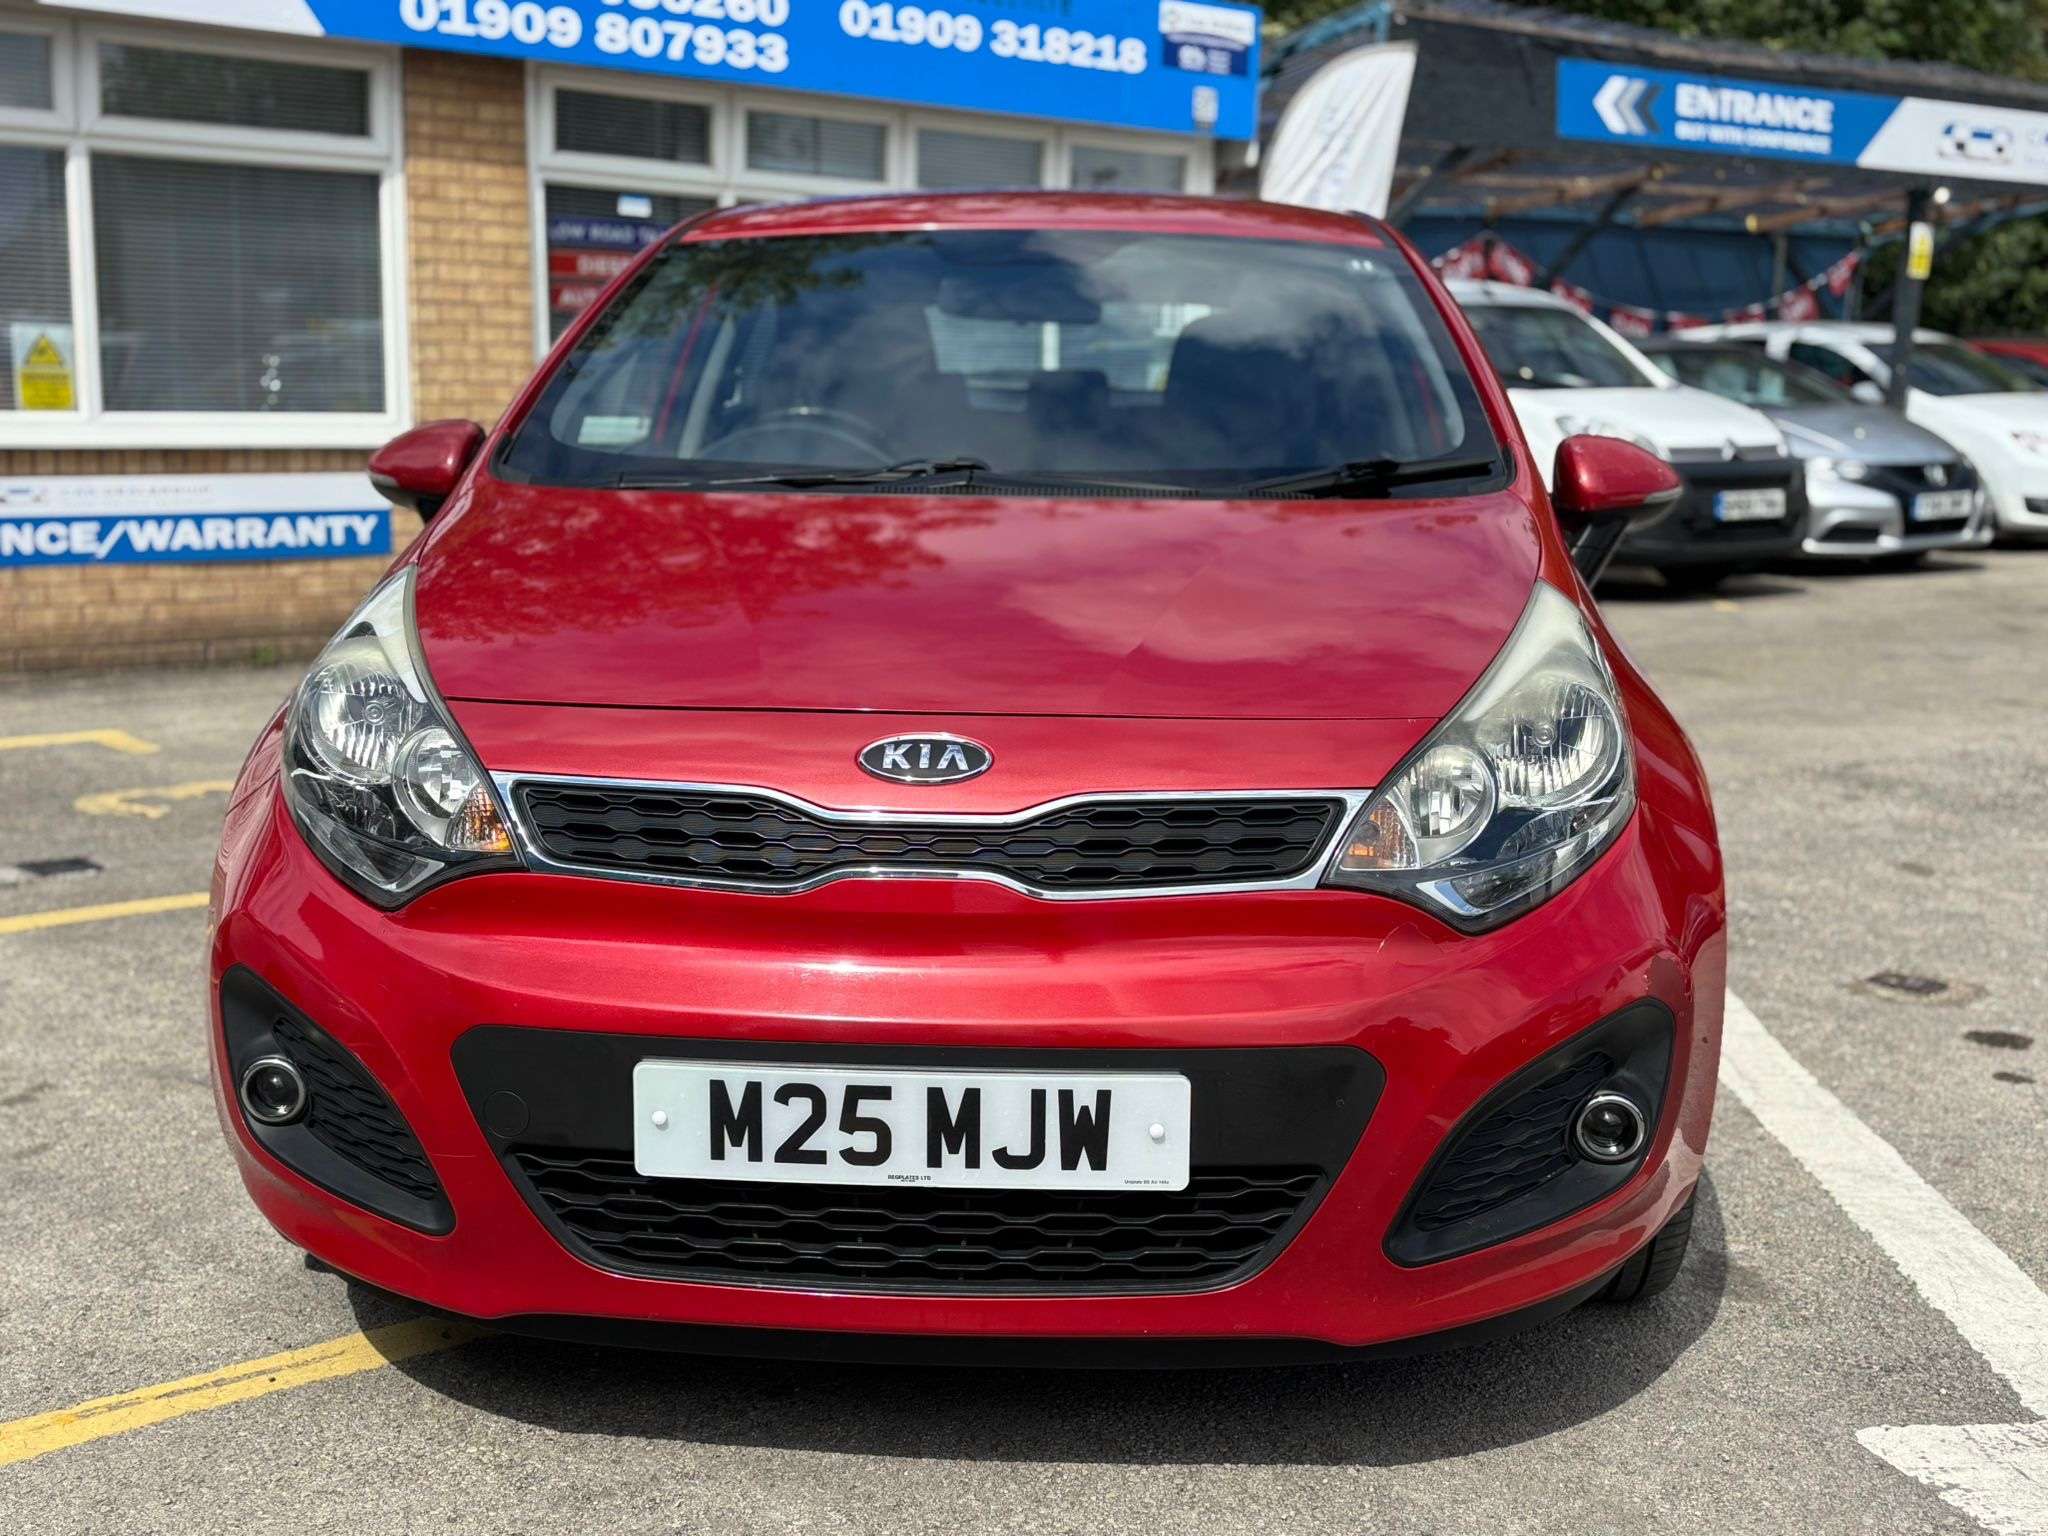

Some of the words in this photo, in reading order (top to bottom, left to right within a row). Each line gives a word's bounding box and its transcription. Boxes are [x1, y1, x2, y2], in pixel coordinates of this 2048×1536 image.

[400, 0, 583, 48] 01909
[594, 12, 790, 73] 807933
[839, 0, 983, 52] 01909
[990, 19, 1148, 74] 318218
[1675, 82, 1835, 133] ENTRANCE
[882, 743, 970, 771] KIA
[709, 1079, 893, 1167] M25
[927, 1086, 1112, 1170] MJW
